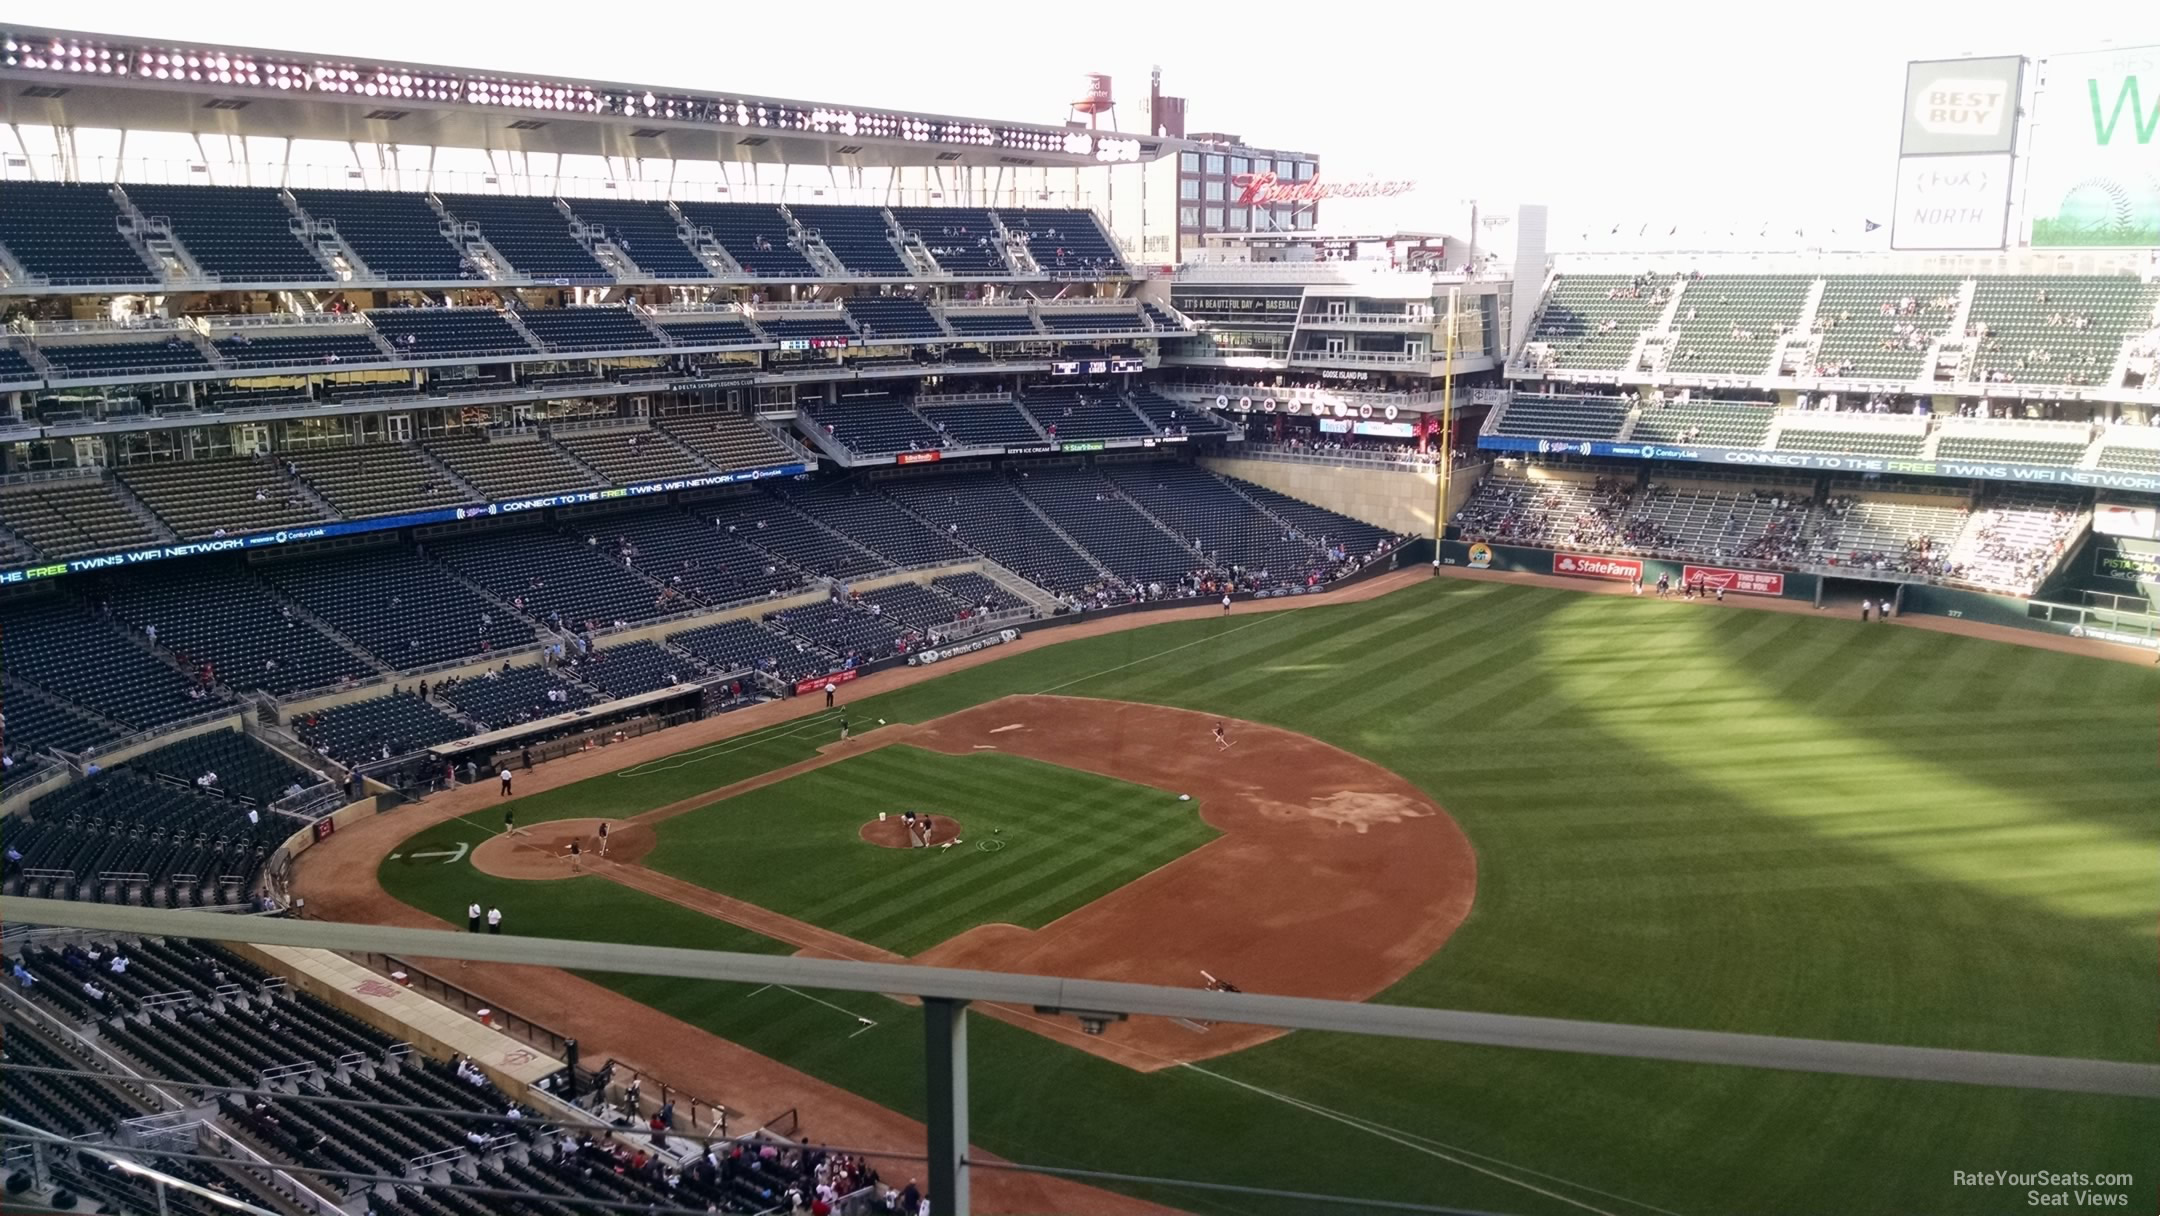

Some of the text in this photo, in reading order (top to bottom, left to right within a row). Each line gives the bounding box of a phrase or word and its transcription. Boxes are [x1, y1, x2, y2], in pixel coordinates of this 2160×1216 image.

[1928, 91, 2001, 108] BEST
[1928, 108, 1991, 125] BUY
[2087, 75, 2160, 146] W
[1232, 171, 1416, 208] Budweiser
[1913, 207, 1984, 225] NORTH
[1199, 299, 1204, 309] A
[1205, 299, 1240, 309] BEAUTIFUL
[1241, 300, 1253, 309] DAY
[1265, 300, 1299, 310] BASEBALL
[717, 380, 740, 388] LEGENDS
[740, 379, 754, 387] CLUB
[1322, 370, 1368, 380] GOOSE ISLAND PUB
[1655, 447, 1699, 460] CenturyLink
[1724, 451, 1810, 467] CONNECT
[1815, 456, 1841, 468] TO
[1848, 457, 1883, 471] THE
[1887, 459, 1937, 474] FREE
[1942, 462, 2007, 478] TWINS
[2013, 466, 2056, 481] WIFI
[502, 498, 557, 512] CONNECT
[560, 495, 575, 504] TO
[577, 492, 599, 502] THE
[600, 488, 628, 499] FREE
[629, 484, 662, 494] TWINS
[664, 481, 685, 490] WIFI
[686, 474, 734, 488] NETWORK
[287, 528, 325, 541] CenturyLink
[26, 563, 68, 579] FREE
[71, 554, 125, 572] TWINS
[127, 549, 162, 563] WIFI
[165, 538, 245, 558] NETWORK
[1737, 581, 1753, 590] FOR
[1738, 573, 1755, 583] THIS
[953, 644, 971, 655] Music
[972, 641, 982, 650] Go
[982, 636, 1001, 647] Twins
